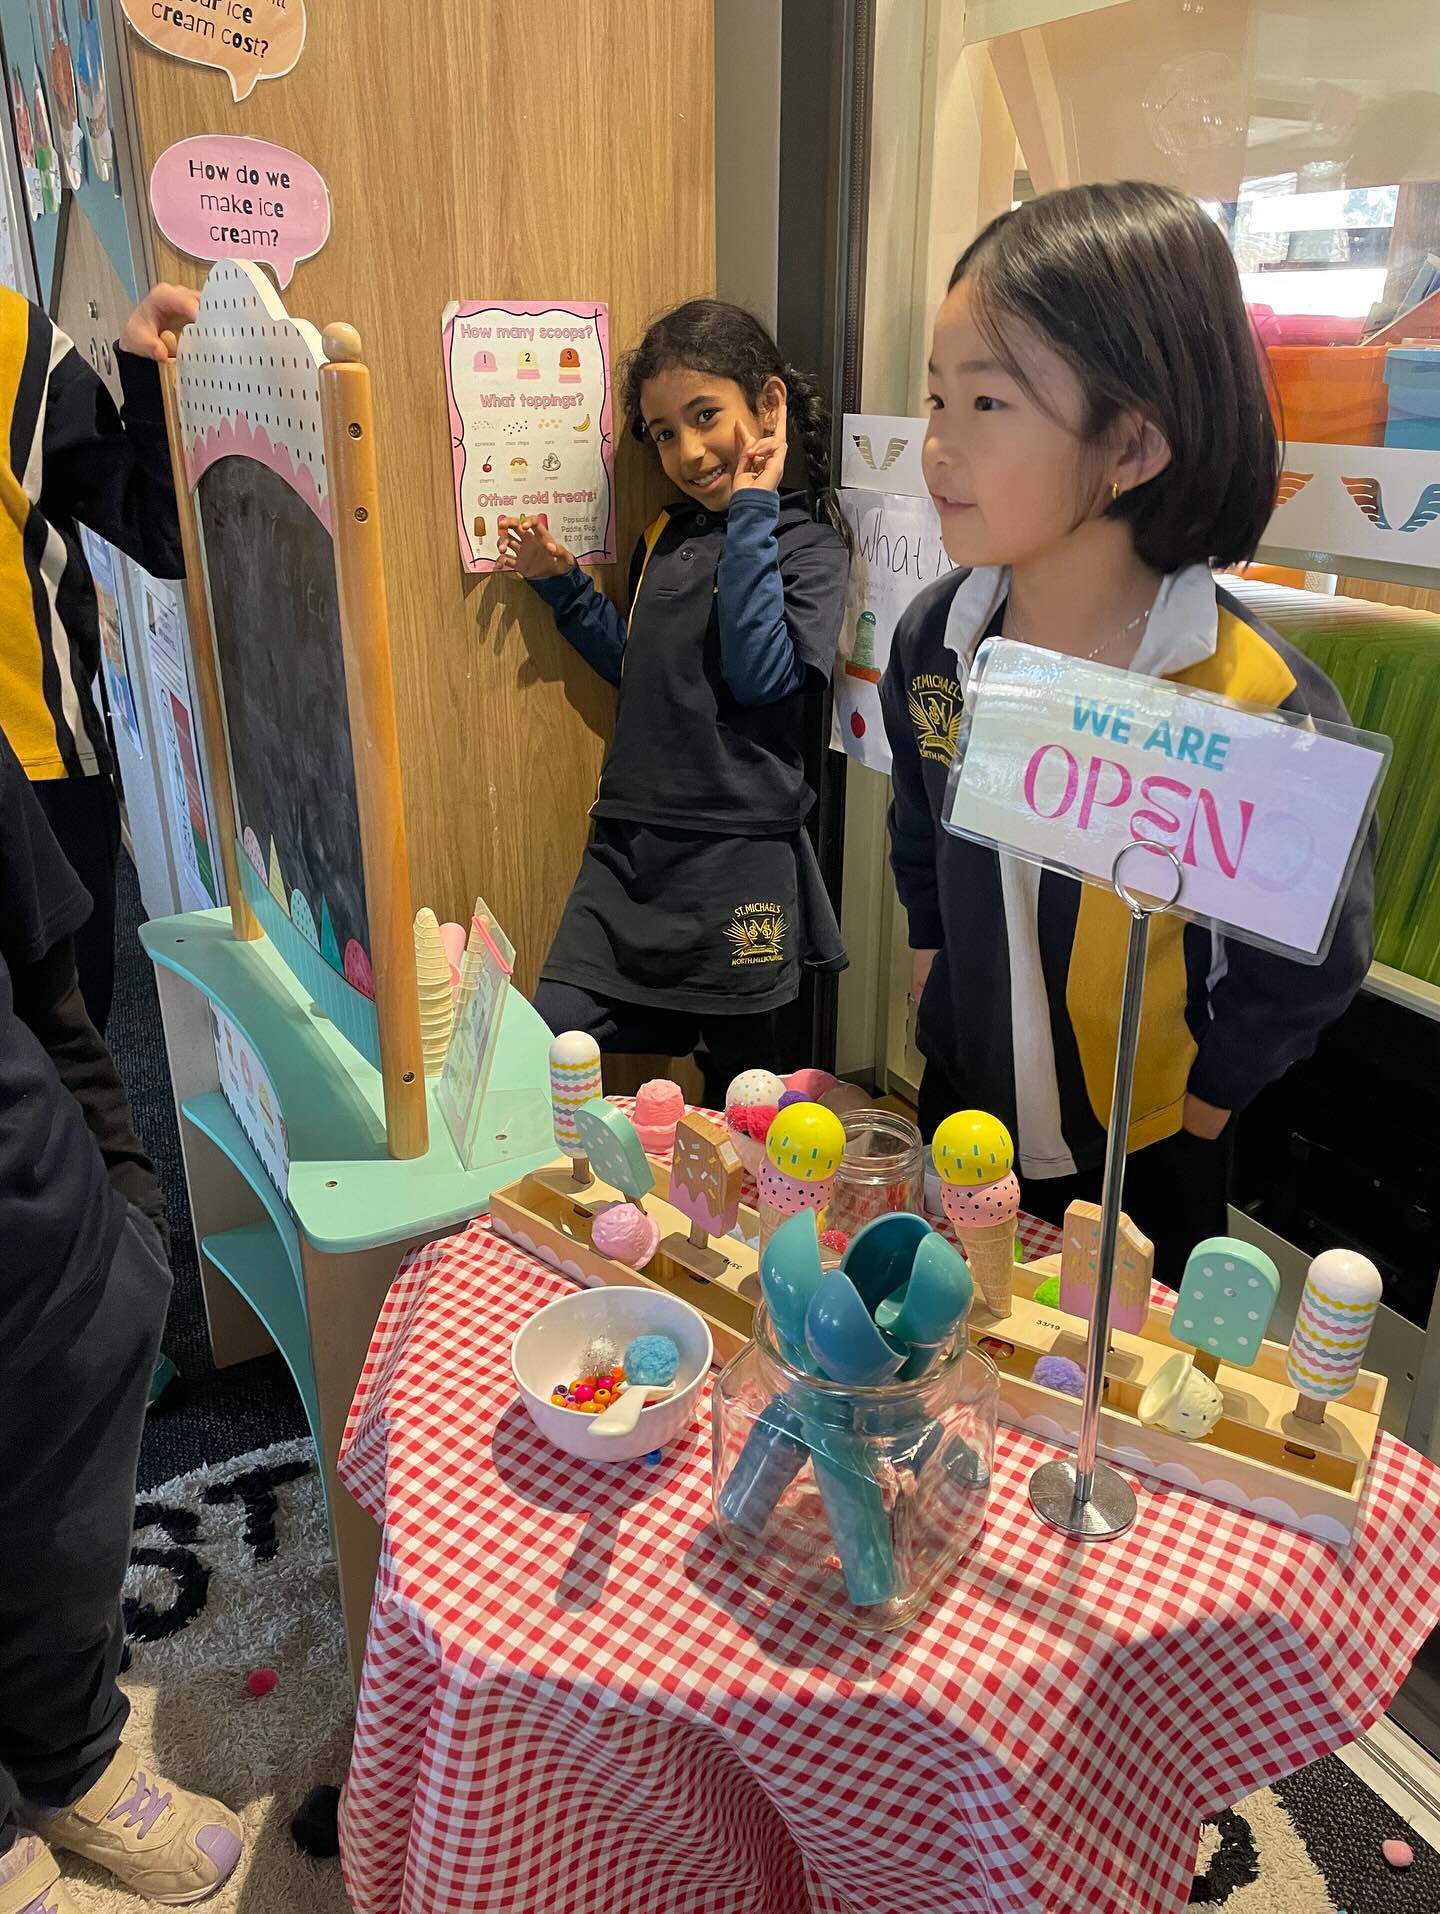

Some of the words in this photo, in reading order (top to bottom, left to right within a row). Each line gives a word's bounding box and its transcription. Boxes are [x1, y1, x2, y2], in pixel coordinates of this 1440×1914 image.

[226, 0, 253, 23] ice
[151, 2, 215, 39] cream
[221, 28, 269, 58] cost?
[189, 159, 230, 179] How
[236, 165, 259, 184] do
[266, 170, 291, 189] we
[200, 193, 252, 214] make
[258, 197, 284, 218] ice
[210, 225, 279, 247] cream?
[461, 323, 492, 339] How
[496, 326, 534, 342] many
[539, 325, 593, 342] scoops?
[524, 352, 531, 363] 2
[566, 350, 573, 361] 3
[480, 393, 516, 408] What
[520, 392, 585, 410] toppings?
[478, 493, 517, 508] Other
[522, 491, 549, 505] cold
[553, 489, 597, 504] treats:
[856, 507, 923, 580] What
[1072, 695, 1135, 745] WE
[1143, 720, 1231, 771] ARE
[1023, 743, 1255, 879] OPEN
[1035, 1319, 1061, 1331] 33/19
